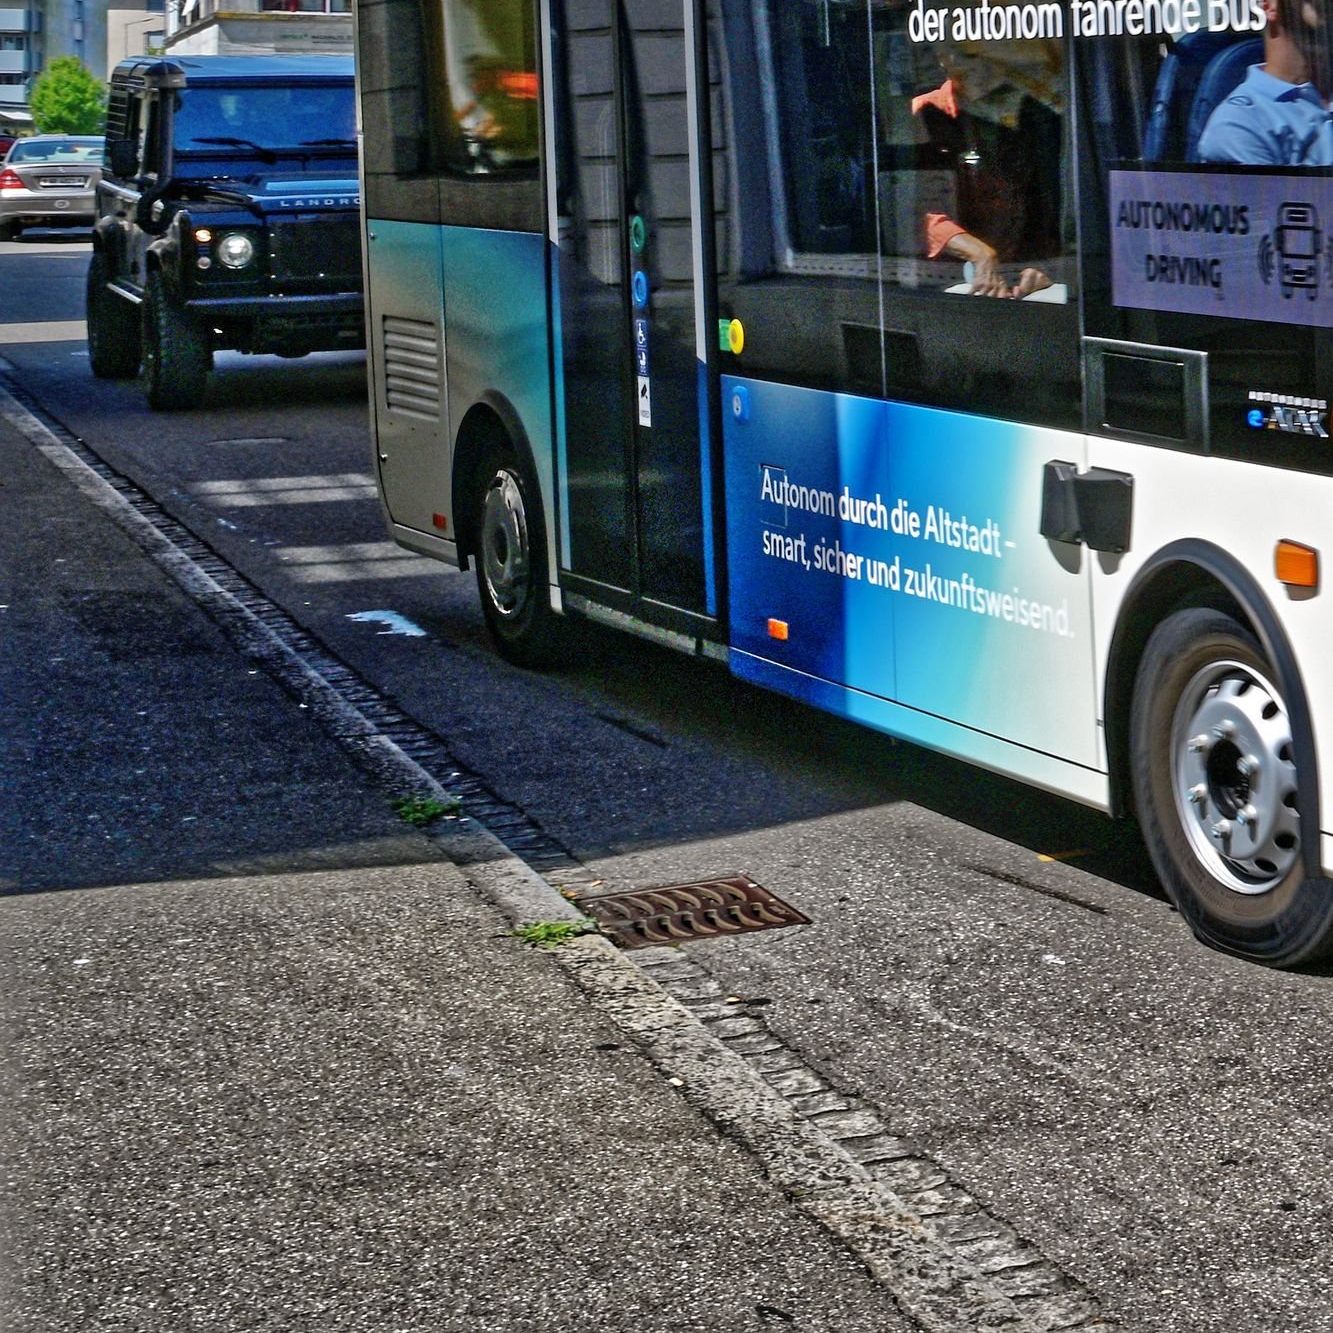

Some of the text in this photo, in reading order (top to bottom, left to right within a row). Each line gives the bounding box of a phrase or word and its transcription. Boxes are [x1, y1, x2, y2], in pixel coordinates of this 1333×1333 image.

[1116, 199, 1250, 236] AUTONOMOUS
[1144, 253, 1223, 289] DRIVING
[760, 468, 836, 516] Autonom
[838, 486, 888, 531] durch
[891, 497, 921, 538] die
[924, 504, 1002, 558] Altstadt
[762, 529, 1076, 638] smart, sicher und zukunftsweisend.
